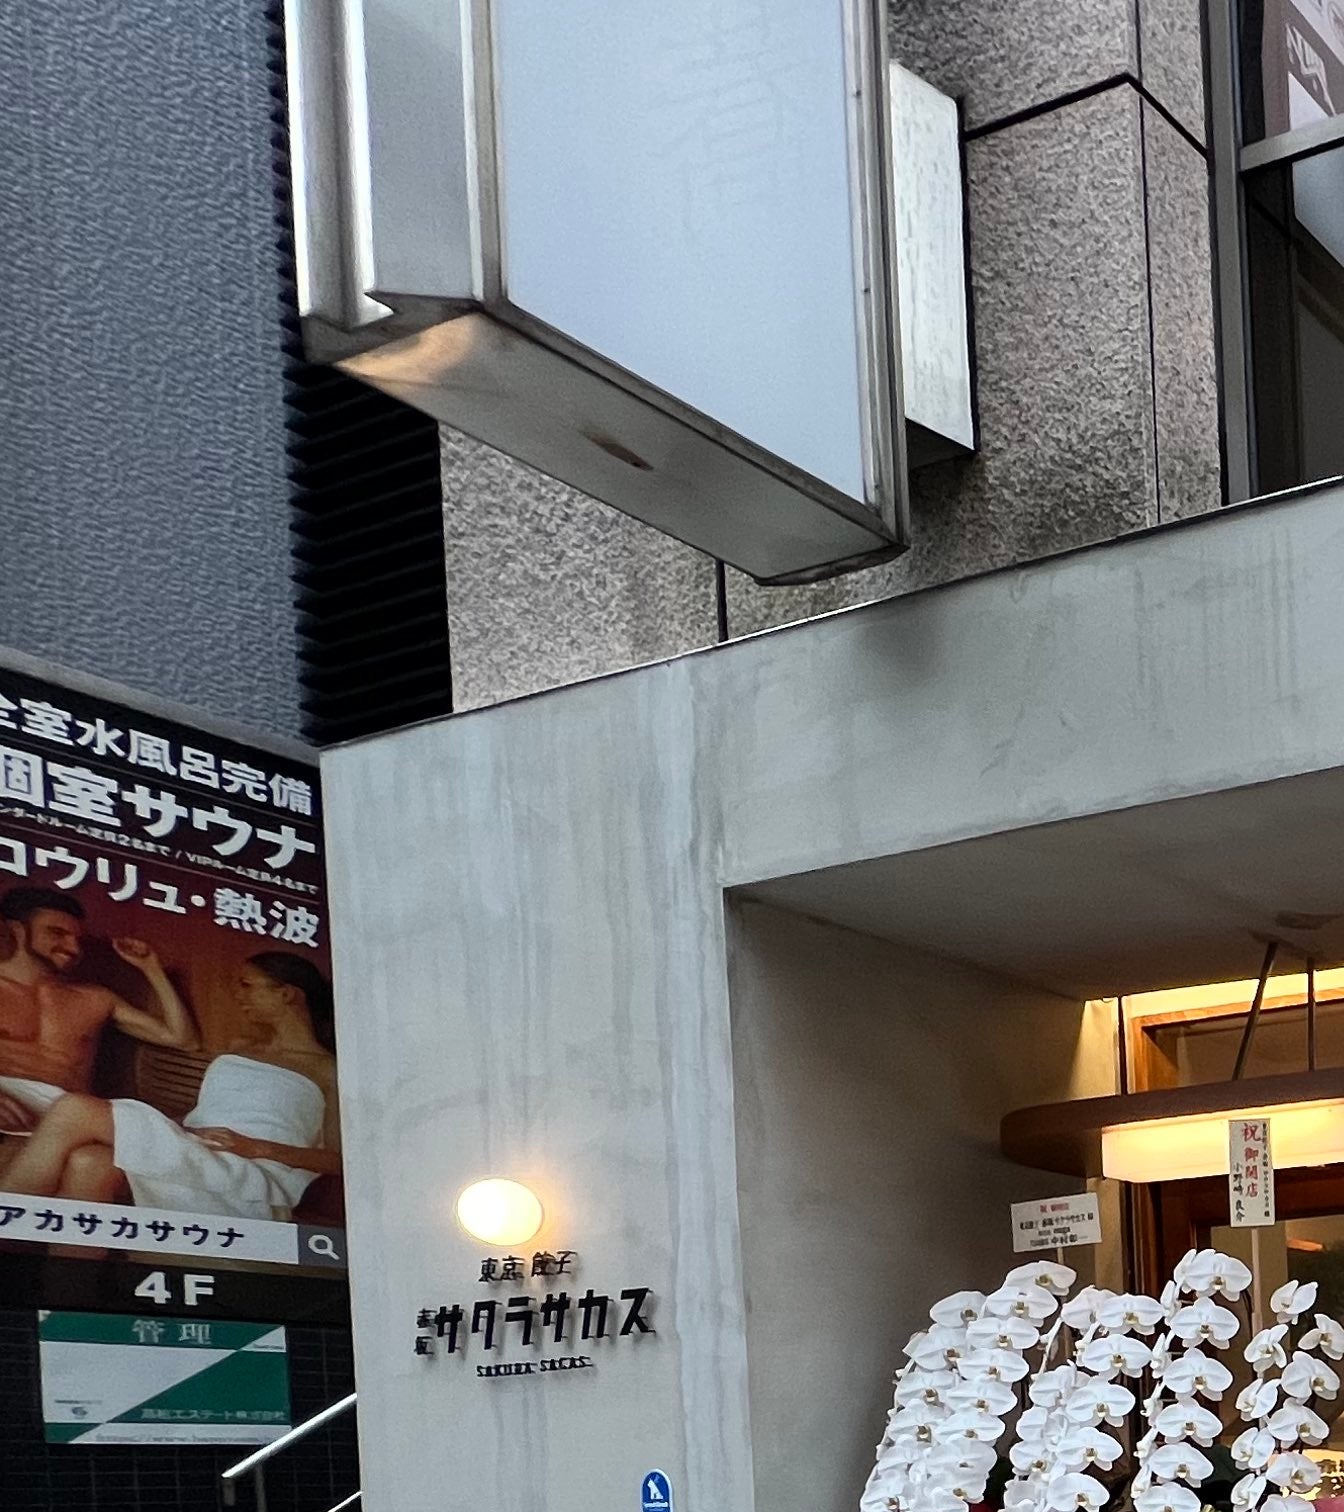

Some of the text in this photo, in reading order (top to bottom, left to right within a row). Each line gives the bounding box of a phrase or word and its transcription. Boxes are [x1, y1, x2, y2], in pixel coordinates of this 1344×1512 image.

[0, 1204, 245, 1248] アカサカサウナ
[134, 1271, 215, 1306] 4F
[434, 1287, 656, 1354] サクラサカス
